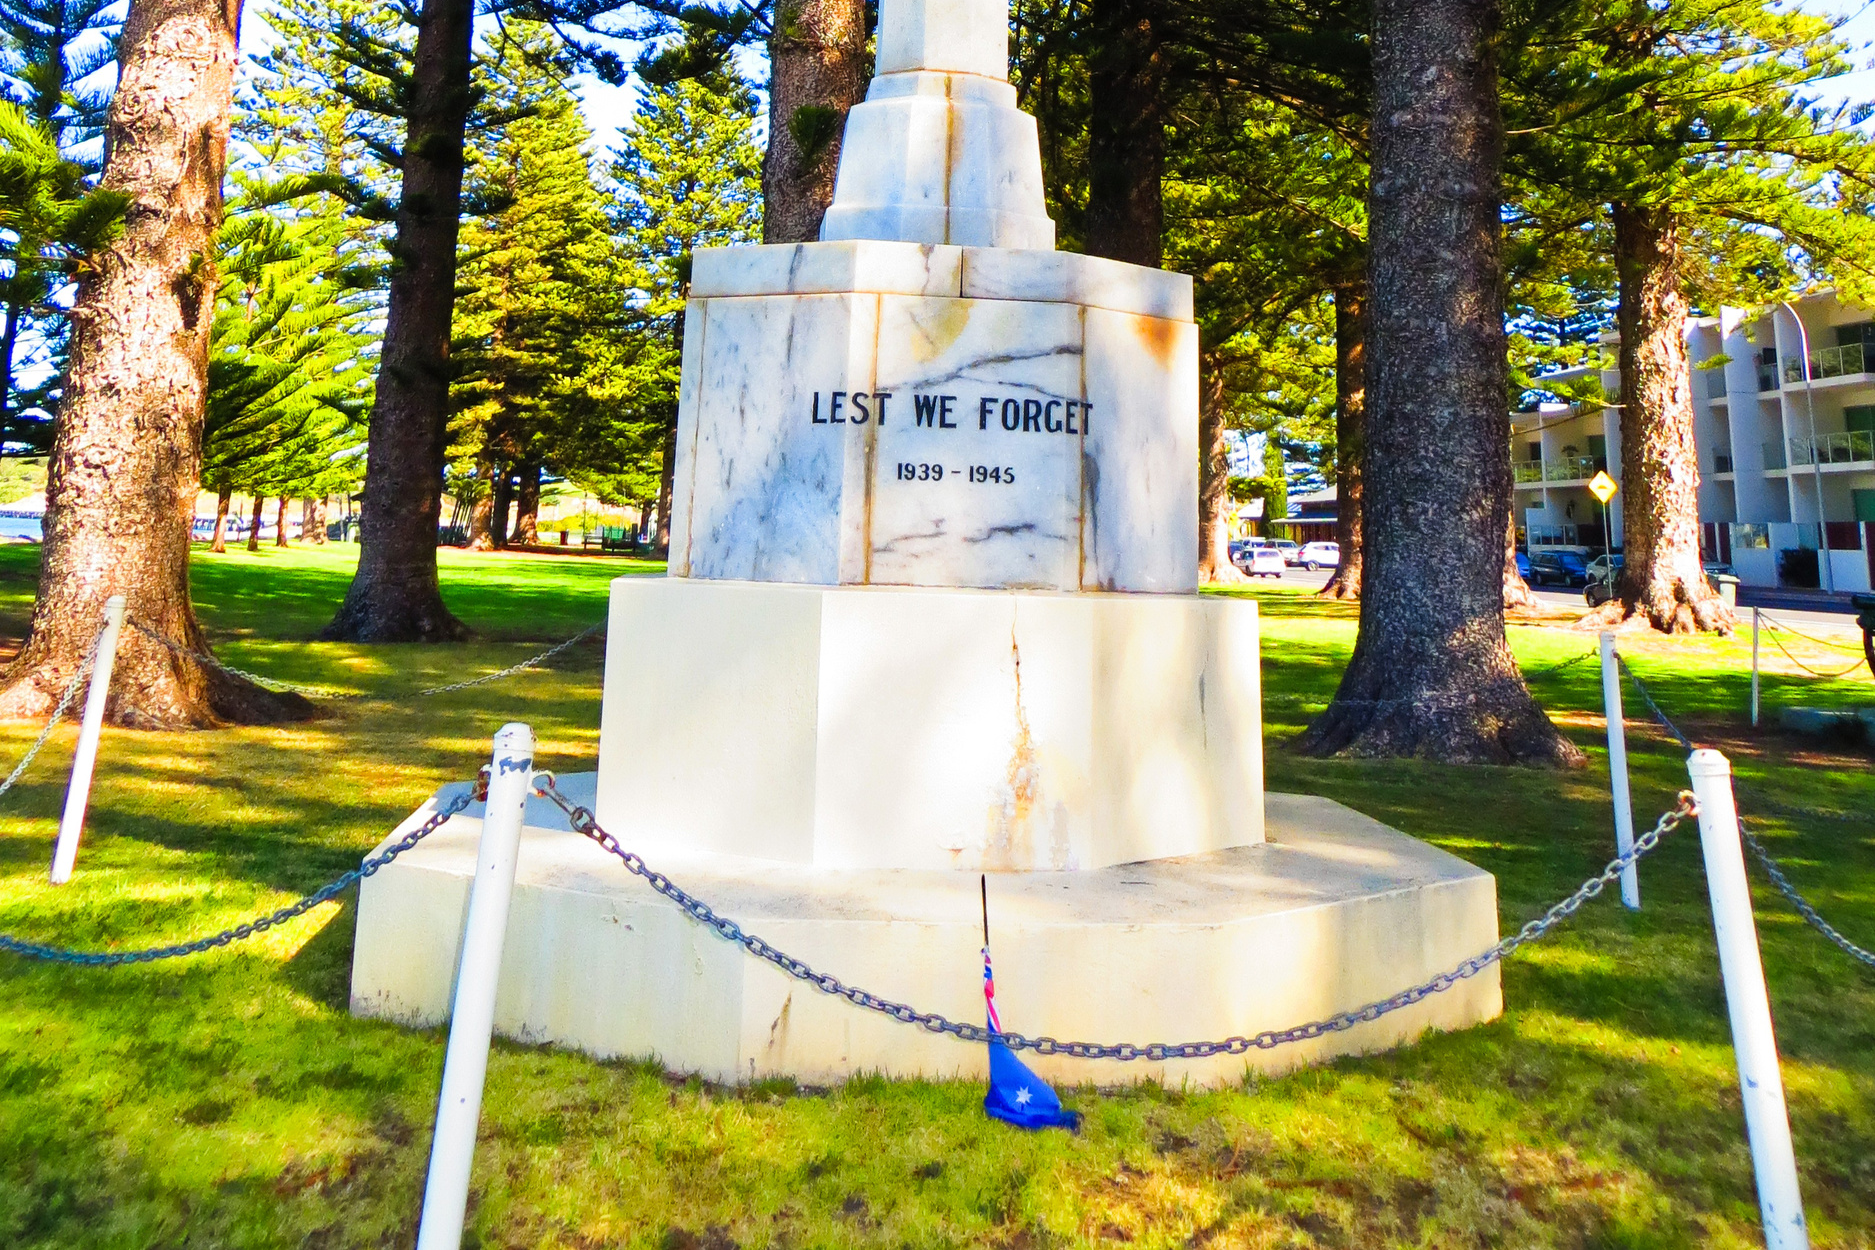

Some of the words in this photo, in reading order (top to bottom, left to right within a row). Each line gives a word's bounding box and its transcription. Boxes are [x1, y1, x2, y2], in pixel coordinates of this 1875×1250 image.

[812, 391, 892, 425] LEST
[914, 395, 958, 428] WE
[979, 397, 1093, 435] FORGET
